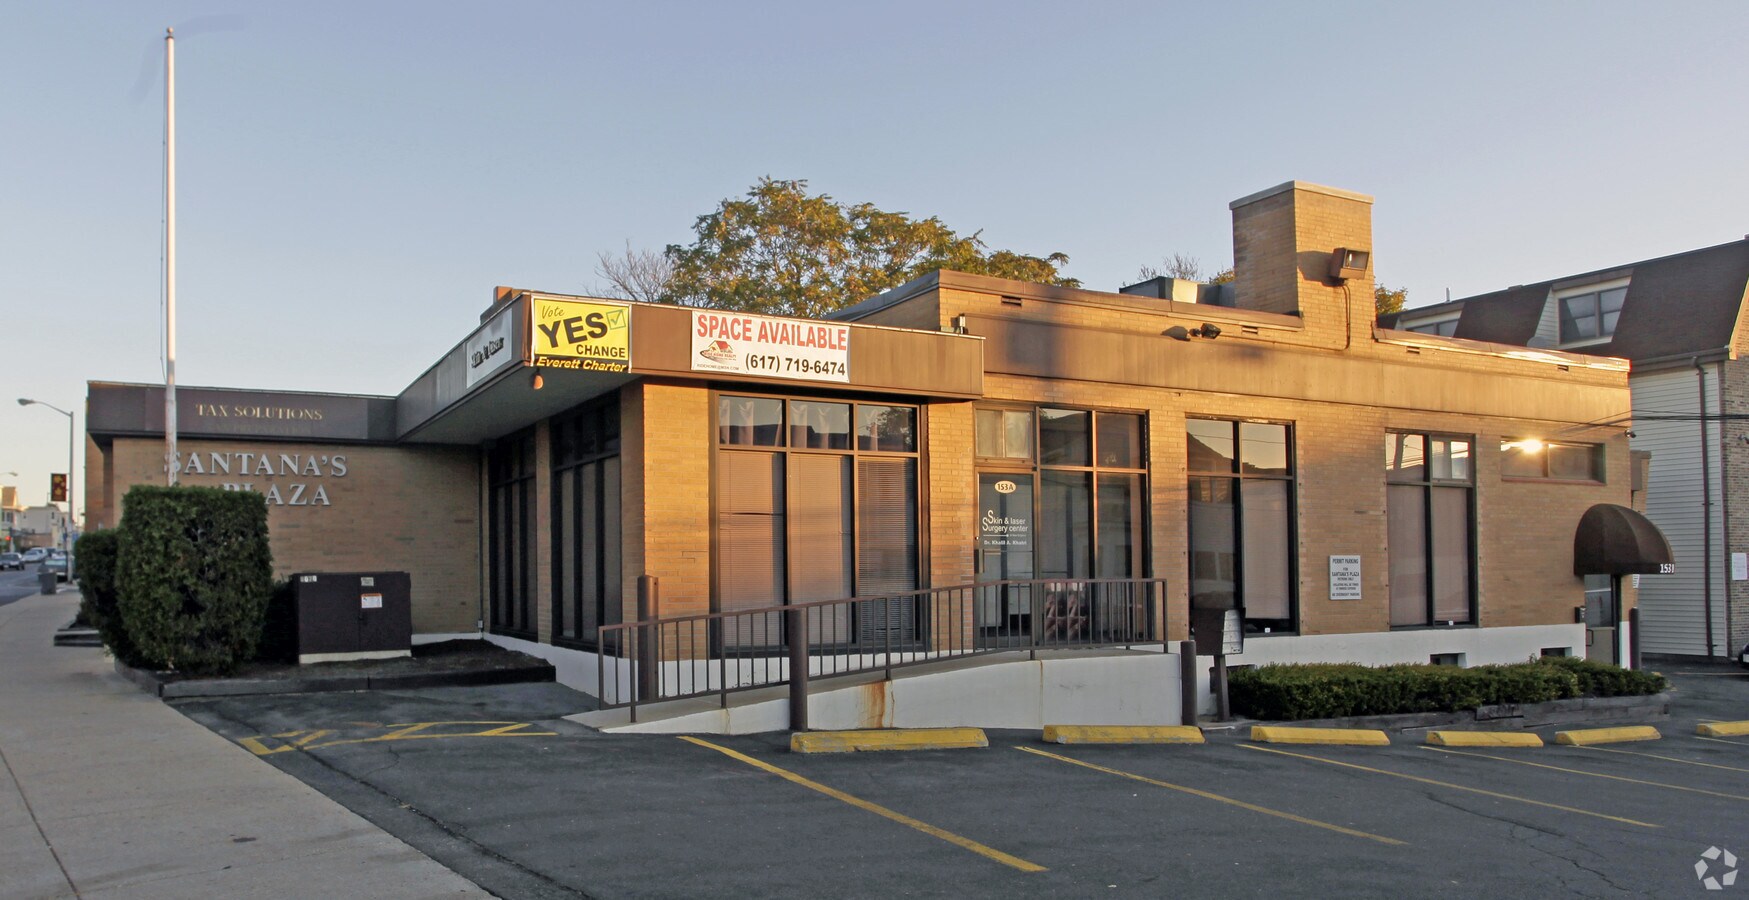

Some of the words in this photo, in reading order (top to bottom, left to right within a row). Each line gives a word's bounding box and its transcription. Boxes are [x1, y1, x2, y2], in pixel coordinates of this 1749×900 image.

[541, 305, 565, 319] Vote
[538, 312, 608, 349] YES
[697, 314, 752, 342] SPACE
[757, 320, 847, 351] AVAILABLE
[576, 344, 626, 358] CHANGE
[536, 356, 580, 370] Everett
[582, 359, 627, 372] Charter
[745, 353, 781, 373] (617)
[785, 358, 846, 376] 719-6474
[195, 403, 229, 417] TAX
[234, 406, 323, 420] SOLUTIONS
[982, 517, 1008, 533] Surgery
[988, 510, 1002, 524] Skin
